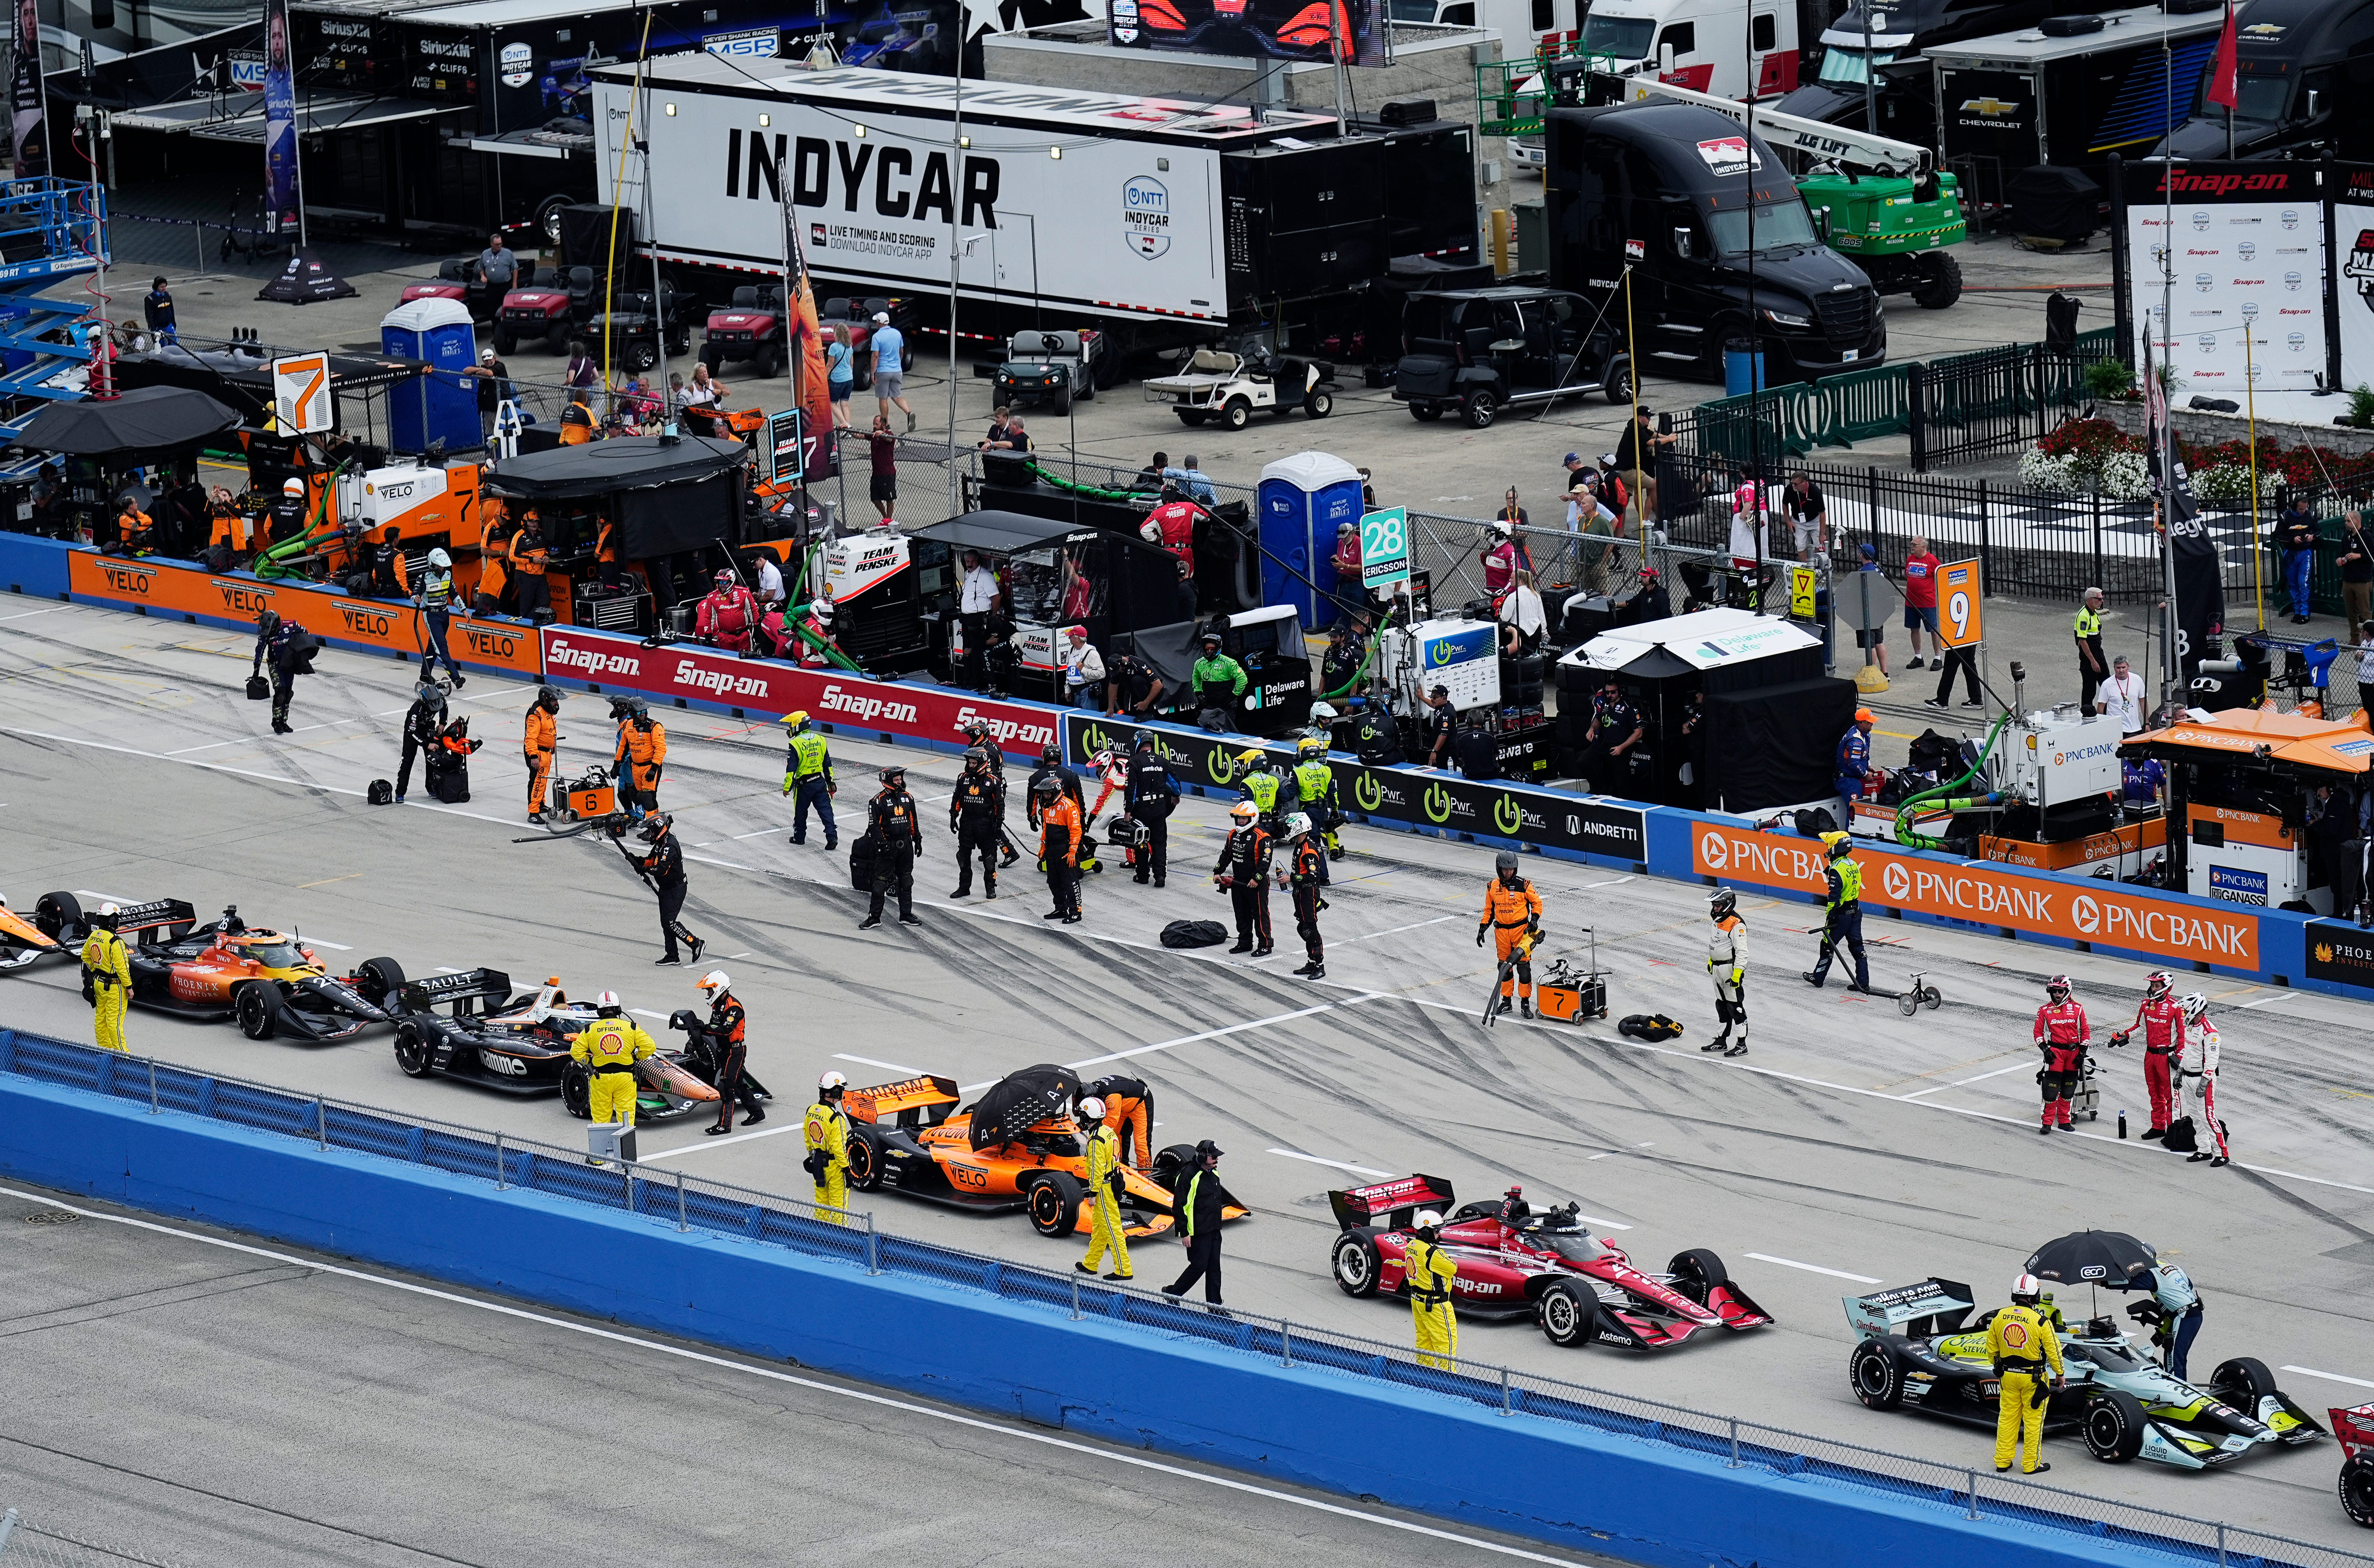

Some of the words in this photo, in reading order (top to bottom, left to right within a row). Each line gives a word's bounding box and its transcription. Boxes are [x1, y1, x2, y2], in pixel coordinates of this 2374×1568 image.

[321, 20, 370, 38] SiriusXM
[704, 35, 727, 44] MEYER
[728, 32, 751, 41] SHANK
[752, 28, 777, 37] RACING
[420, 40, 470, 58] SiriusXM
[513, 50, 527, 58] NTT
[708, 38, 775, 54] MSR
[440, 63, 467, 75] CLIFFS
[501, 61, 532, 71] INDYCAR
[1487, 125, 1502, 134] JLG
[1960, 119, 2022, 129] CHEVROLET
[1794, 133, 1819, 147] JLG
[1820, 138, 1851, 156] LIFT
[1715, 162, 1749, 175] INDYCAR
[726, 128, 999, 230] INDYCAR
[2156, 169, 2287, 195] Snap-on
[1142, 191, 1163, 205] NTT
[1125, 211, 1169, 227] INDYCAR
[830, 225, 847, 237] LIVE
[849, 227, 878, 241] TIMING
[879, 231, 897, 243] AND
[899, 234, 935, 248] SCORING
[1134, 224, 1159, 233] SERIES
[830, 238, 876, 254] DOWNLOAD
[878, 242, 913, 259] INDYCAR
[914, 249, 931, 260] APP
[1589, 279, 1619, 289] INDYCAR
[278, 358, 324, 430] 7
[775, 444, 797, 457] PENSKE
[778, 437, 796, 448] TEAM
[381, 486, 412, 499] VELO
[454, 489, 473, 522] 7
[1066, 532, 1097, 542] Snap-on
[1364, 517, 1403, 559] 28
[863, 546, 894, 560] TEAM
[855, 557, 898, 574] PENSKE
[1365, 560, 1406, 578] ERICSSON
[105, 569, 148, 593] VELO
[221, 588, 266, 613] VELO
[342, 610, 388, 636] VELO
[1949, 591, 1970, 639] 9
[466, 632, 514, 657] VELO
[1028, 635, 1048, 644] TEAM
[1719, 628, 1783, 646] Delaware
[1022, 642, 1051, 653] PENSKE
[1734, 643, 1757, 654] Life
[547, 639, 640, 675] Snap-on
[673, 659, 768, 696] Snap-on
[1265, 680, 1305, 695] Delaware
[819, 684, 917, 722] Snap-on
[1266, 696, 1282, 708] Life
[953, 706, 1054, 744] Snap-on
[585, 793, 597, 811] 6
[1584, 821, 1637, 841] ANDRETTI
[2221, 889, 2267, 907] GANASSI
[121, 901, 170, 915] PHOENIX
[218, 917, 229, 930] 26
[368, 963, 383, 979] Firestone
[174, 976, 219, 991] PHOENIX
[178, 987, 218, 997] INVESTORS
[235, 987, 244, 1007] Firestone
[1555, 992, 1565, 1012] 7
[255, 1015, 265, 1035] Firestone
[398, 1020, 417, 1031] Firestone
[484, 1024, 508, 1033] Honda
[534, 1028, 552, 1038] renta
[478, 1047, 528, 1075] Nammo
[706, 1044, 716, 1070] Firestone
[401, 1066, 422, 1075] Firestone
[807, 1112, 824, 1121] OFFICIAL
[854, 1133, 873, 1154] Firestone
[1162, 1151, 1181, 1162] Firestone
[949, 1165, 987, 1187] VELO
[1355, 1181, 1414, 1199] Snap-on
[1501, 1201, 1512, 1218] 2
[1460, 1214, 1481, 1222] TECHNOLOGIES
[1449, 1229, 1477, 1237] Gallagher
[1500, 1247, 1519, 1256] V-Power
[1353, 1272, 1371, 1294] Firestone
[1542, 1285, 1561, 1298] Firestone
[1856, 1319, 1883, 1334] SlimFast
[2003, 1314, 2029, 1324] OFFICIAL
[1556, 1329, 1576, 1342] Firestone
[1599, 1331, 1631, 1345] Astemo
[1851, 1350, 1861, 1382] Firestone
[1883, 1368, 1894, 1401] Firestone
[2108, 1402, 2125, 1428] Firestone
[2082, 1428, 2097, 1456] Firestone
[2145, 1445, 2168, 1454] LIQUID
[2340, 1476, 2351, 1513] Firestone
